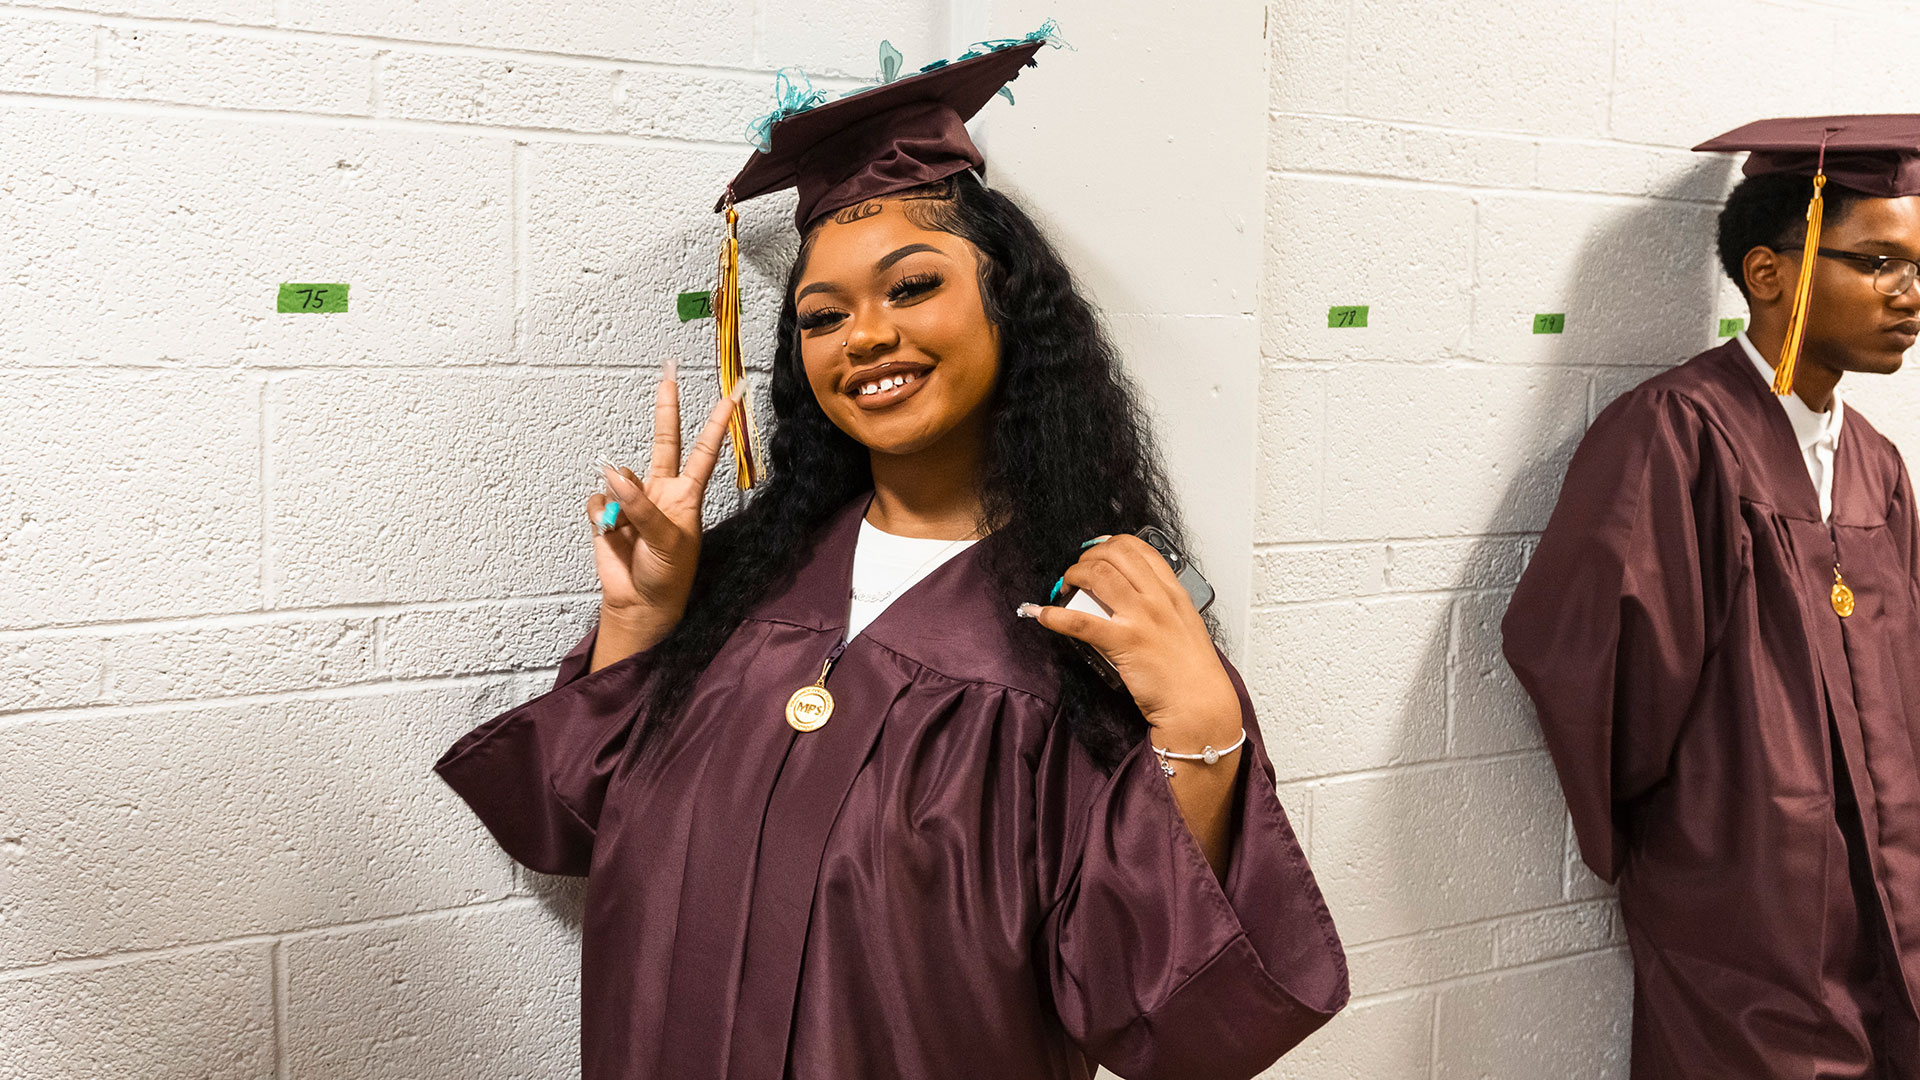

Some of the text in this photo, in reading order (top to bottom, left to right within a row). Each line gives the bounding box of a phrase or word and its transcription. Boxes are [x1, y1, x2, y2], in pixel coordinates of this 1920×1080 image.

[295, 289, 329, 309] 75
[1337, 309, 1357, 328] 78
[1540, 316, 1556, 331] 79
[796, 701, 823, 716] MPS
